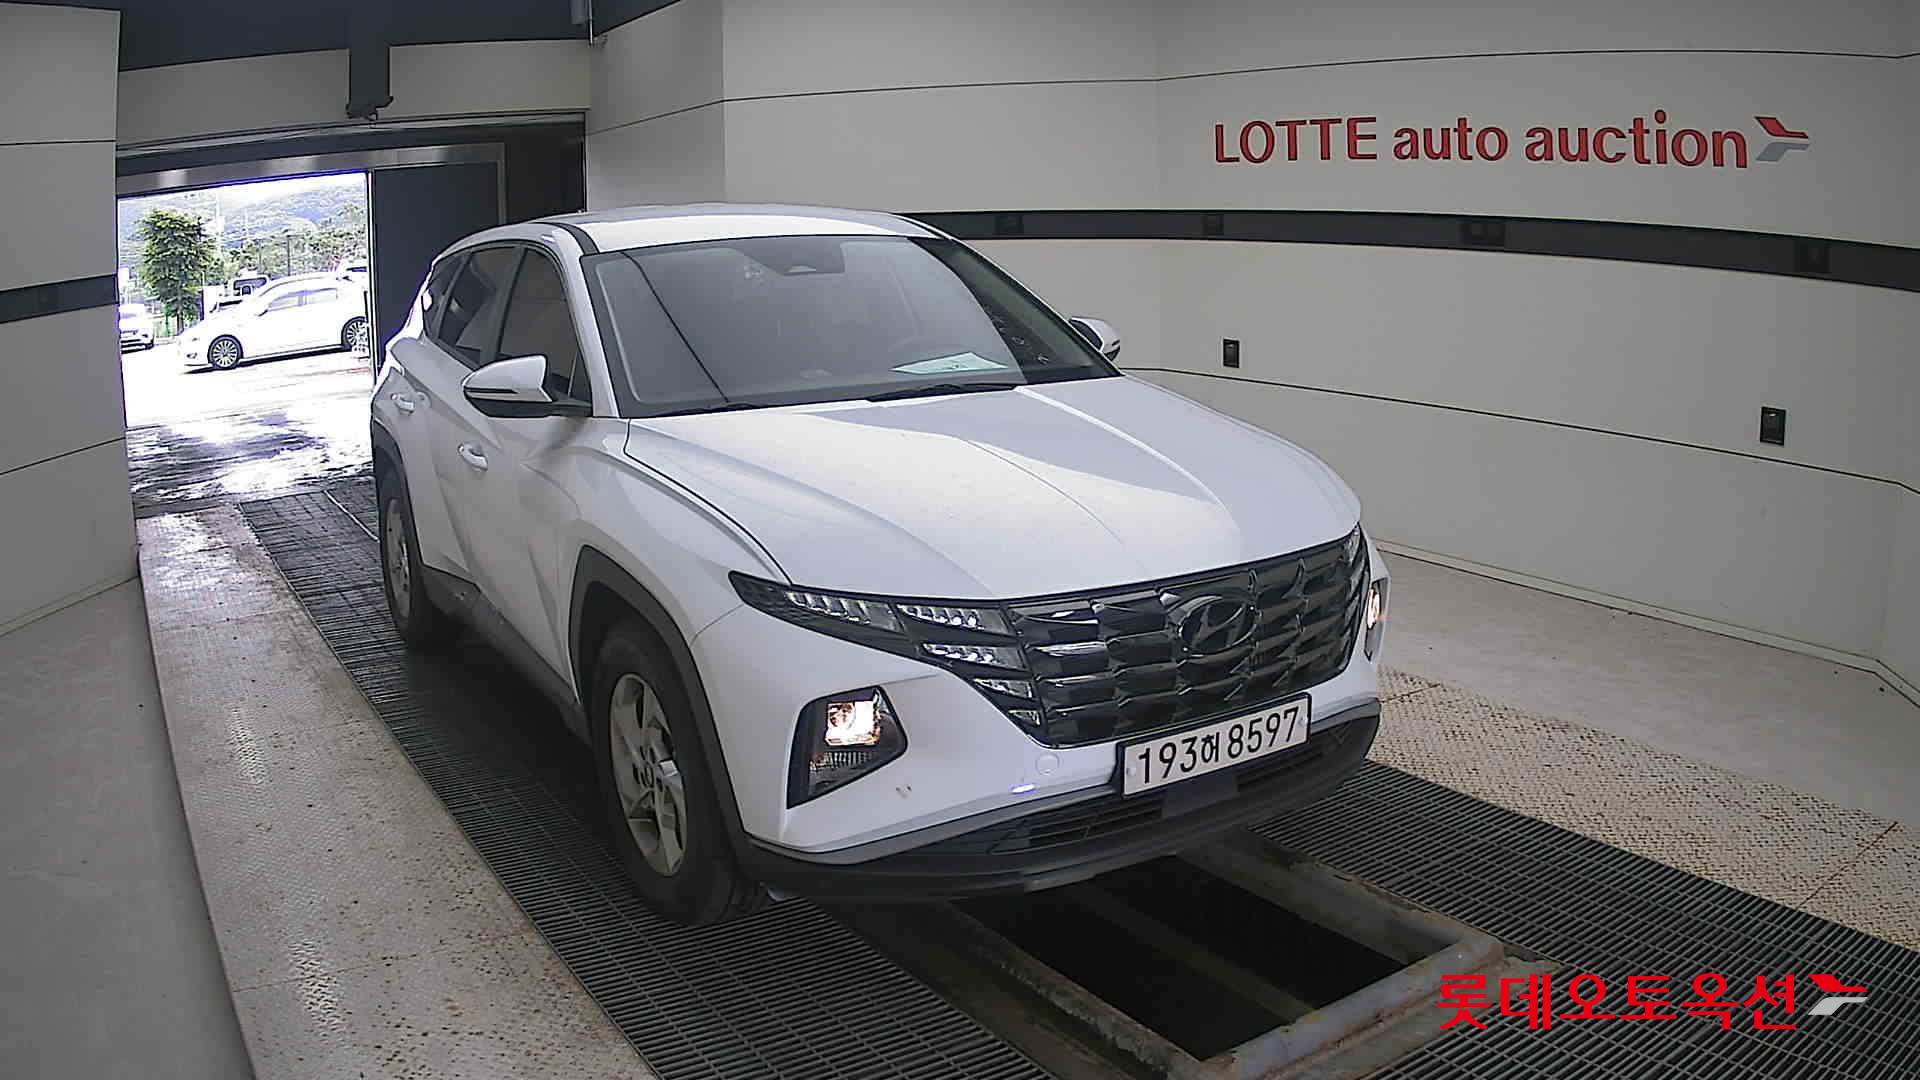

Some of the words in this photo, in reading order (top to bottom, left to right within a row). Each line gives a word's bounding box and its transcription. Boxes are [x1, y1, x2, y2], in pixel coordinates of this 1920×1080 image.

[1214, 116, 1378, 164] LOTTE
[1392, 117, 1509, 161] auto
[1524, 109, 1749, 169] auction
